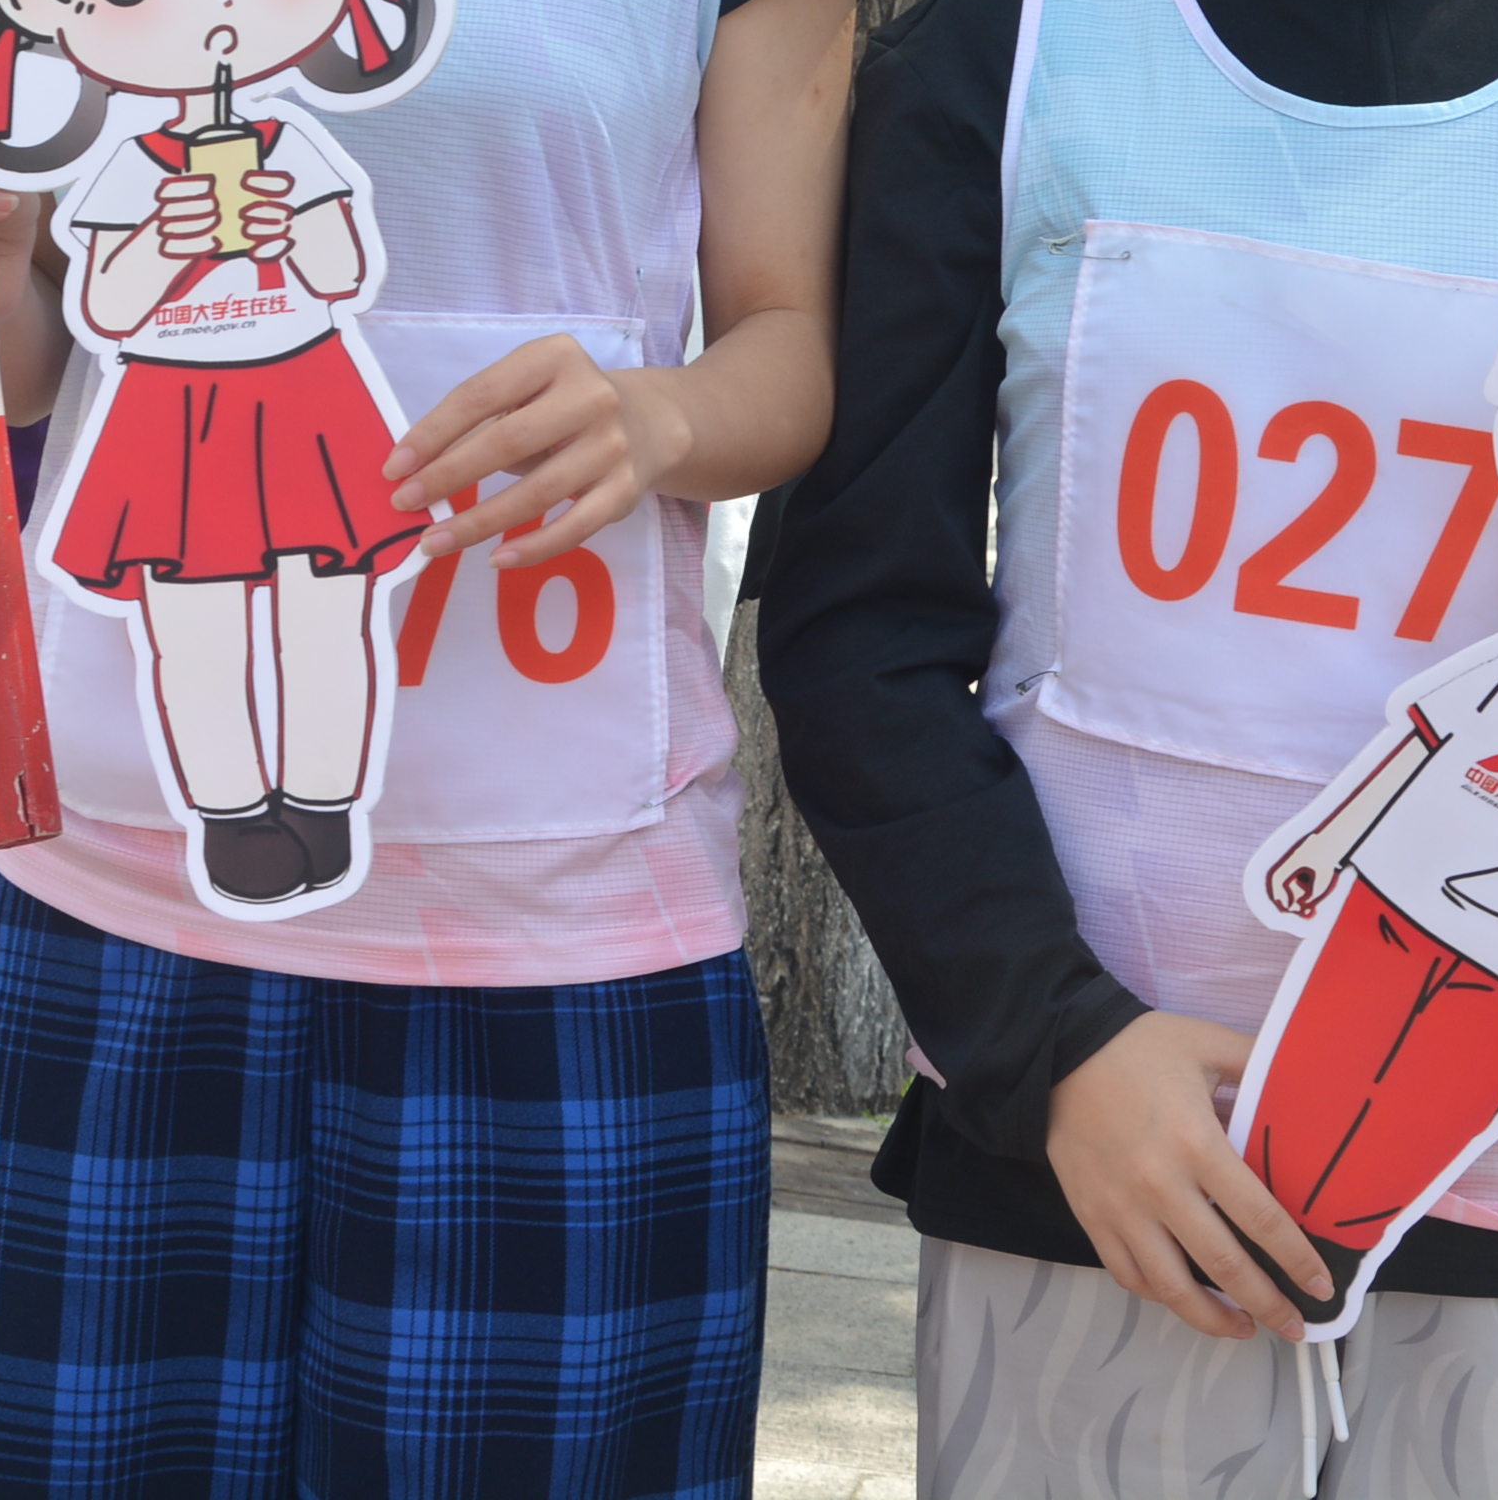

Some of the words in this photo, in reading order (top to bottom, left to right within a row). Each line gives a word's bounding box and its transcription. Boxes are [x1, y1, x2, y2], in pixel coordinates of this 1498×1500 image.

[156, 293, 296, 326] 中国大学生在线
[157, 320, 257, 339] dxs.moe.gov.cn
